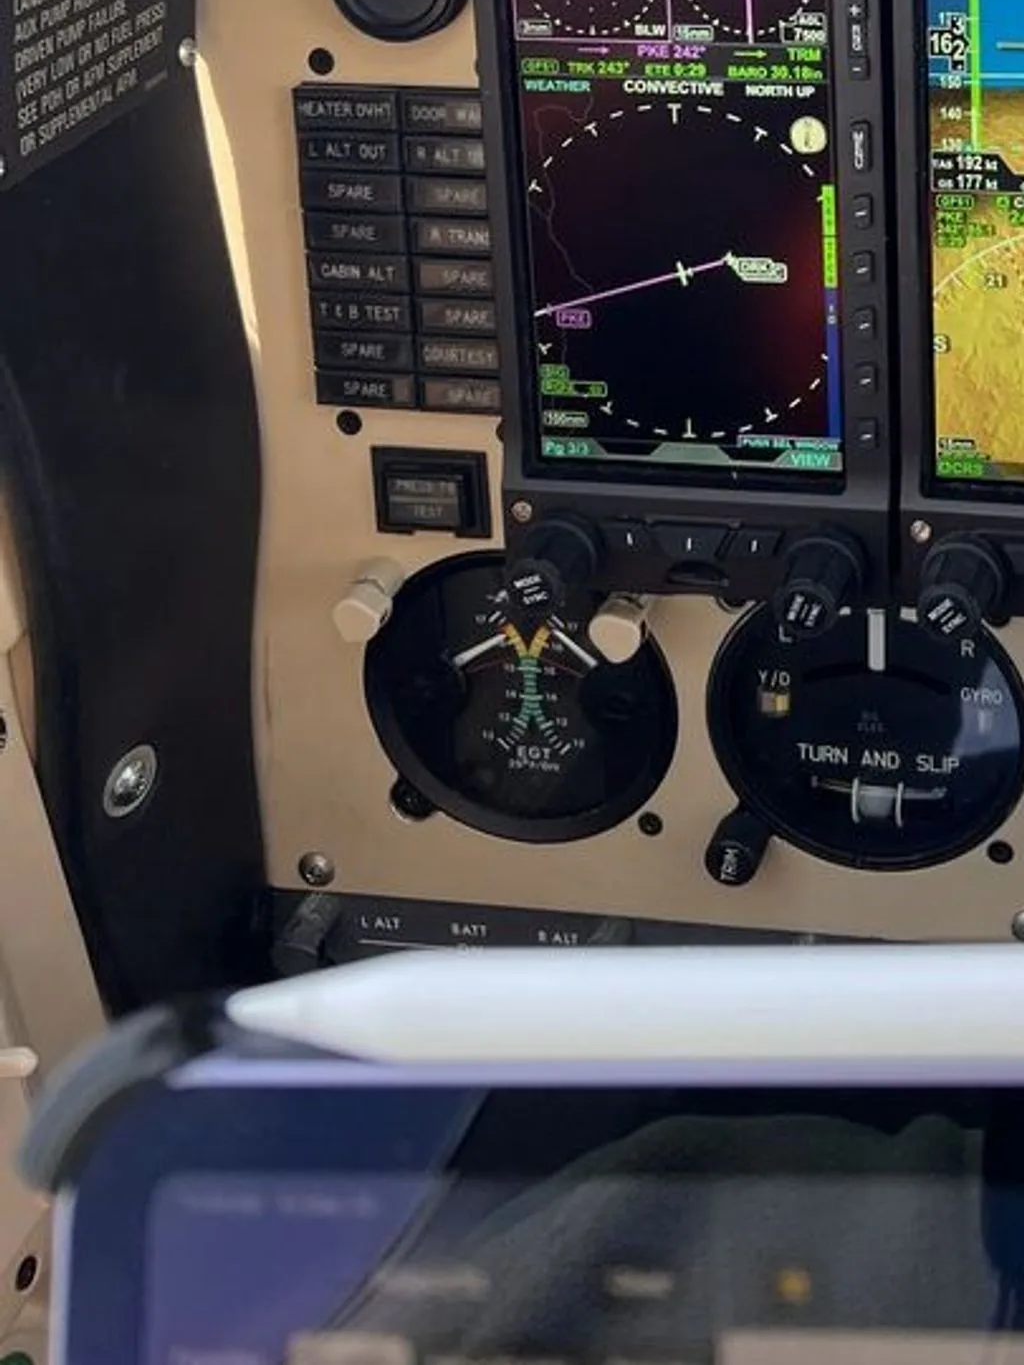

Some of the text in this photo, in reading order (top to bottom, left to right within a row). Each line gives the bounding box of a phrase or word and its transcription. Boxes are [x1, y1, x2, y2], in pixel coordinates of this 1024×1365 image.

[634, 24, 667, 36] BLW
[637, 44, 671, 58] PKE
[786, 47, 821, 62] TRM
[568, 62, 595, 75] TRK
[645, 63, 671, 77] ETE
[727, 65, 767, 79] BARO
[524, 79, 591, 93] WEATHER
[624, 80, 724, 97] CONVECTIVE
[745, 84, 816, 99] NORTH UP
[412, 105, 447, 122] DOOR
[940, 107, 963, 122] 140
[326, 143, 386, 160] ALT OUT
[956, 154, 983, 171] 192
[956, 173, 983, 190] 177
[327, 184, 375, 201] SPARE
[331, 224, 378, 241] SPARE
[320, 263, 395, 282] CABIN ALT
[443, 269, 488, 287] SPARE
[984, 274, 1007, 288] 21
[364, 305, 400, 322] TEST
[444, 309, 488, 325] SPARE
[341, 342, 385, 360] SPARE
[933, 336, 950, 352] S
[422, 345, 494, 364] COURTESY
[343, 381, 387, 398] SPARE
[791, 453, 830, 467] VIEW
[961, 639, 975, 658] R
[757, 670, 790, 687] Y/D
[960, 688, 1001, 705] GYRO
[516, 745, 551, 760] EGT
[797, 742, 960, 774] TURN AND SLIP
[374, 916, 400, 930] ALT
[451, 922, 487, 937] BATT
